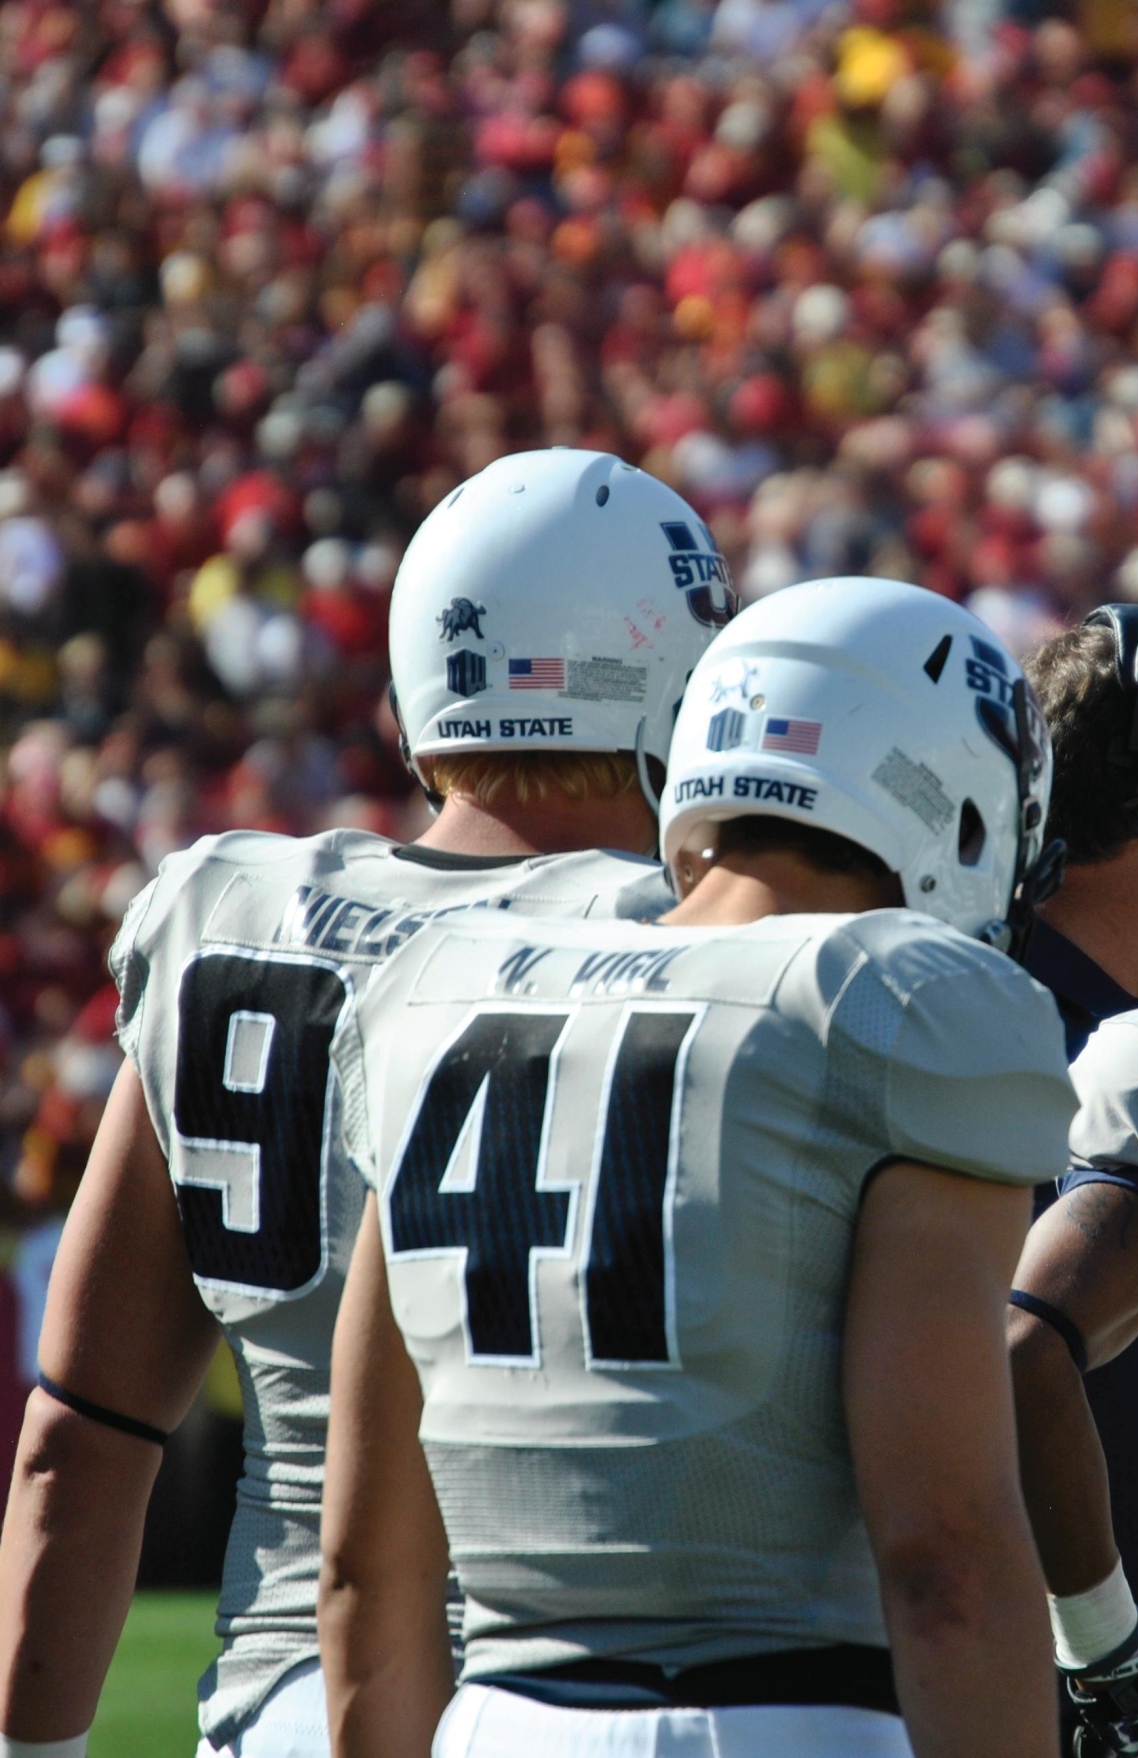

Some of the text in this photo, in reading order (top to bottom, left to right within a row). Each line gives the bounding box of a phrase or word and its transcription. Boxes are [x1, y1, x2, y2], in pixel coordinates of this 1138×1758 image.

[437, 718, 573, 738] UTAH STATE
[674, 774, 818, 811] UTAH STATE
[172, 944, 355, 1301] 9
[387, 1001, 709, 1371] 41
